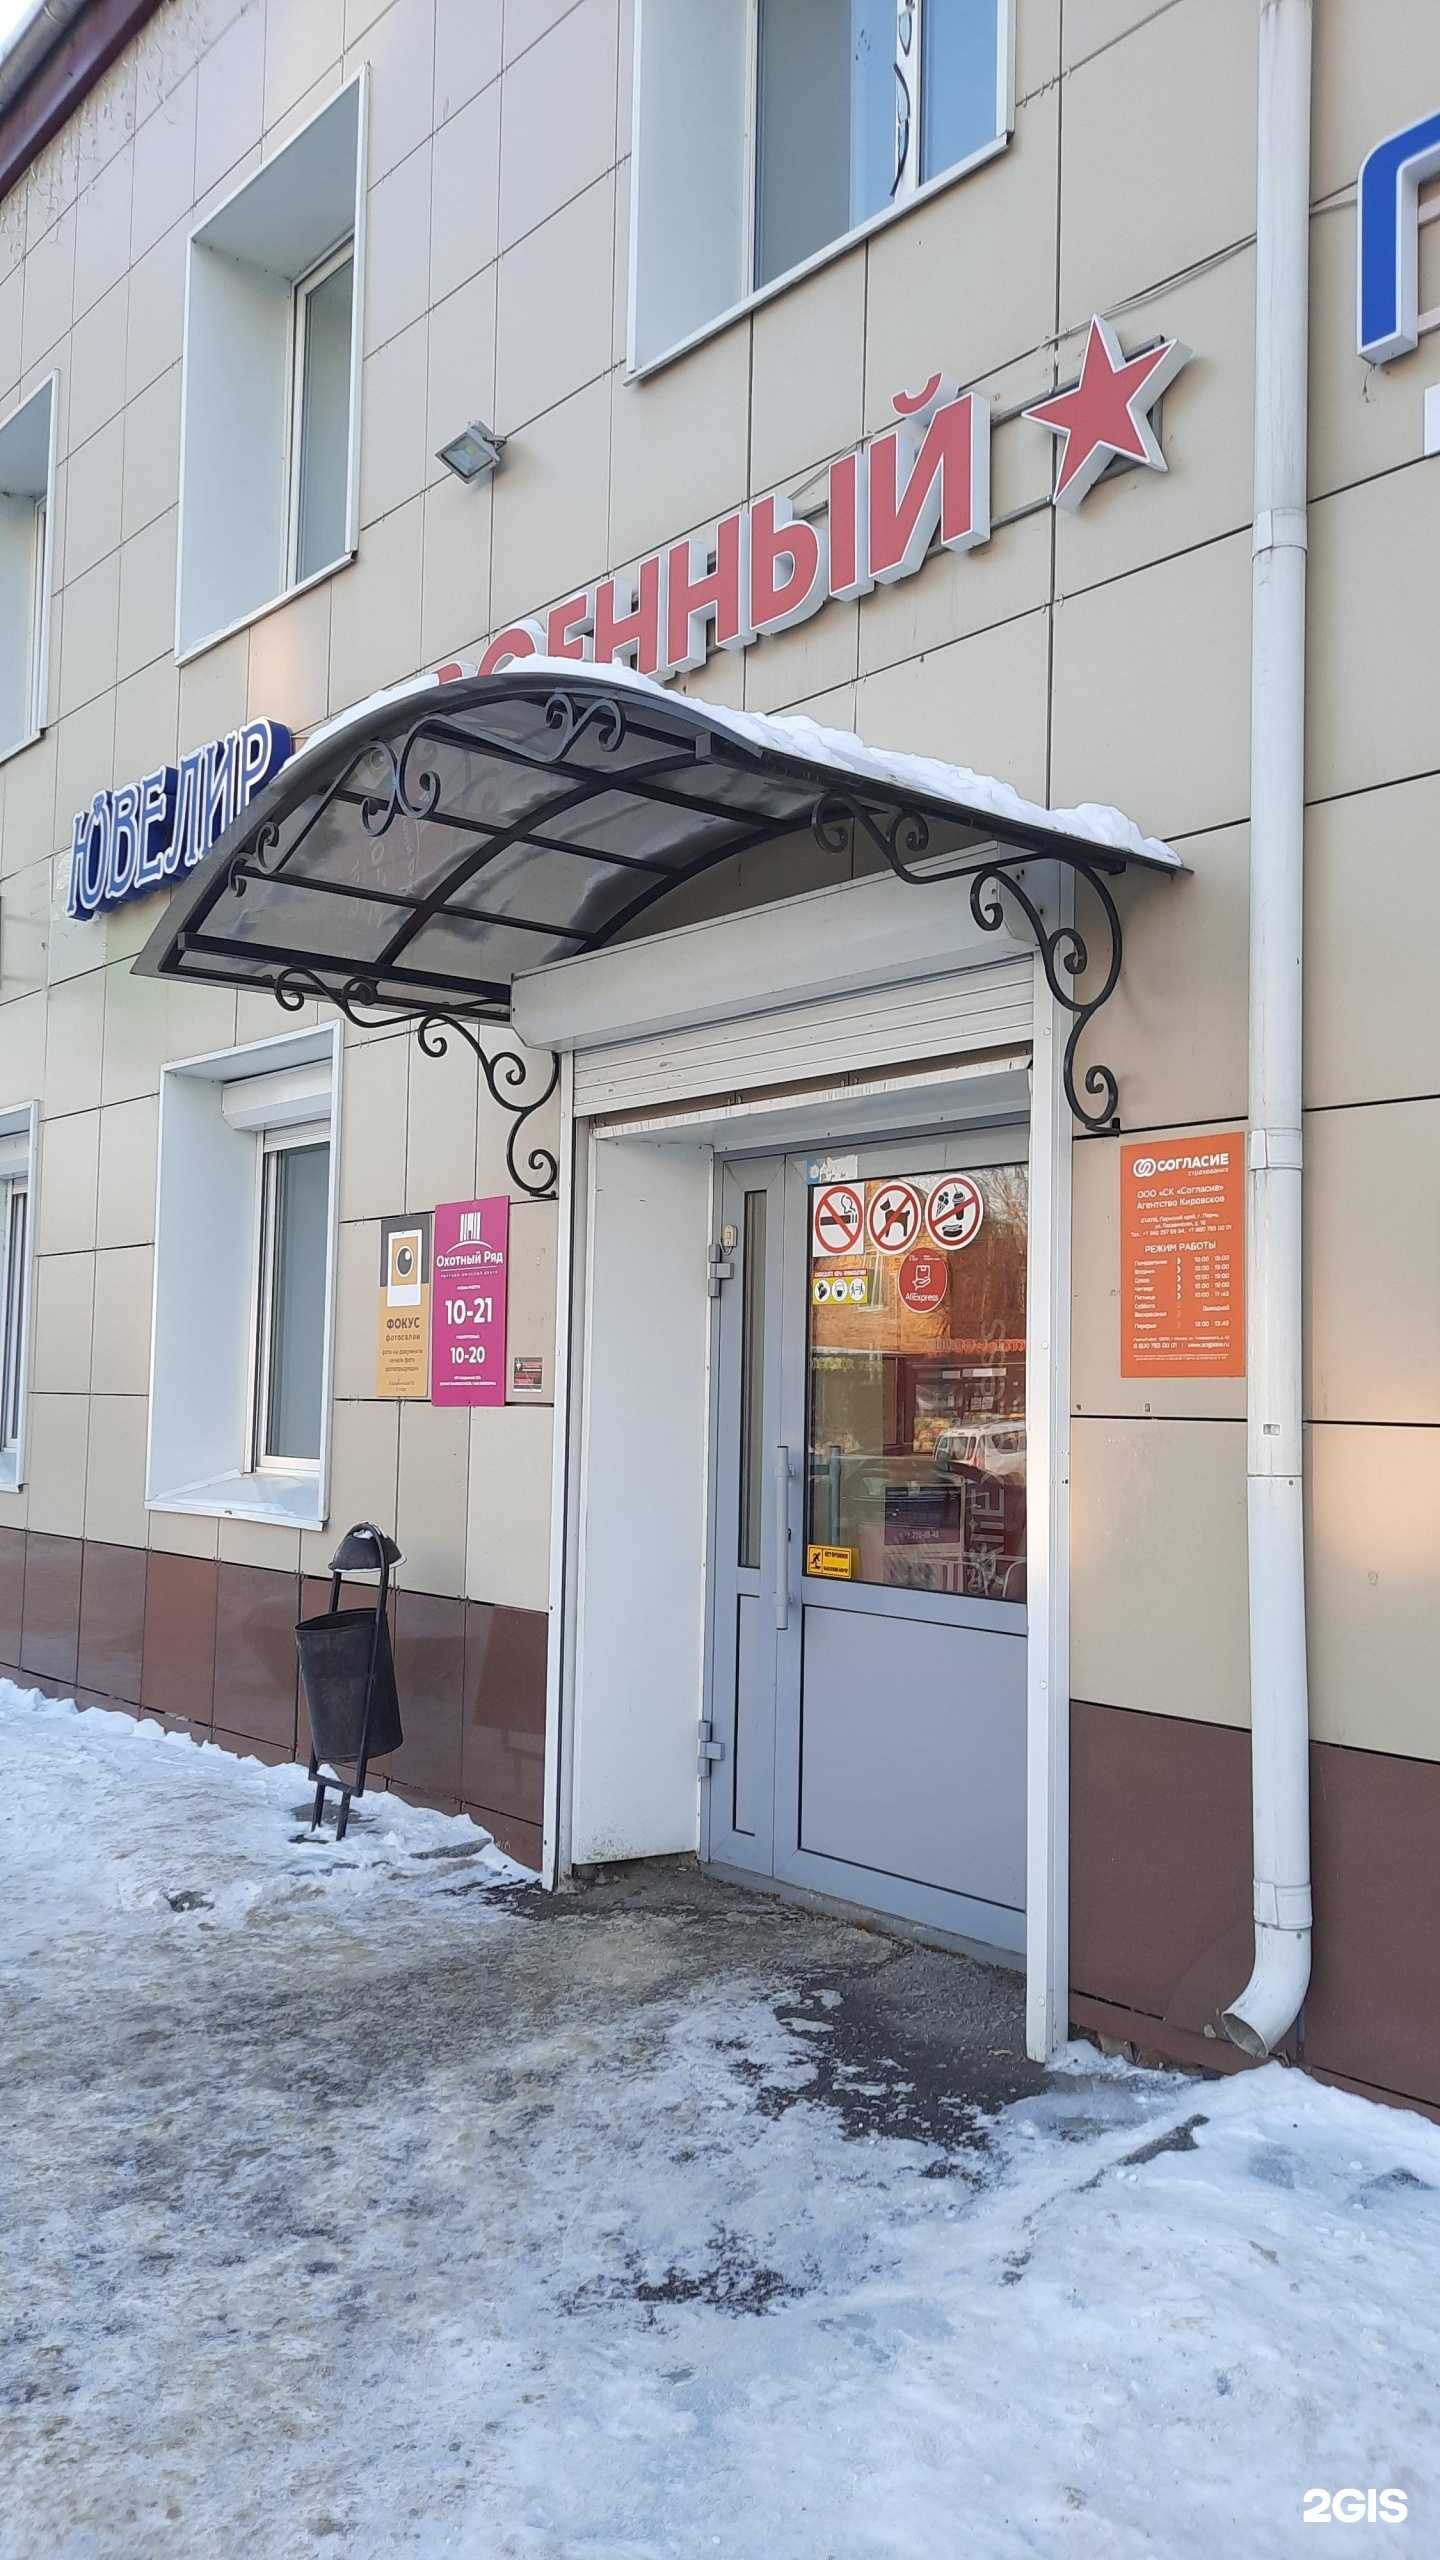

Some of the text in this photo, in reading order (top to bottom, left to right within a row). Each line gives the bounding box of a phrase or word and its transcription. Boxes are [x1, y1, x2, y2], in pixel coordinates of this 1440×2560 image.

[66, 717, 292, 922] ЮВЕЛИР
[1157, 1153, 1229, 1171] СОГЛАСИЕ
[1137, 1190, 1156, 1199] ООО
[1145, 1241, 1216, 1254] РЕЖИМ РАБОТЫ
[436, 1250, 504, 1267] Охотный Ряд
[905, 1293, 939, 1302] AliExpress
[445, 1297, 493, 1325] 10-21
[386, 1316, 421, 1330] ФОКУС
[385, 1334, 421, 1343] фотосалон
[450, 1346, 486, 1364] 10-20
